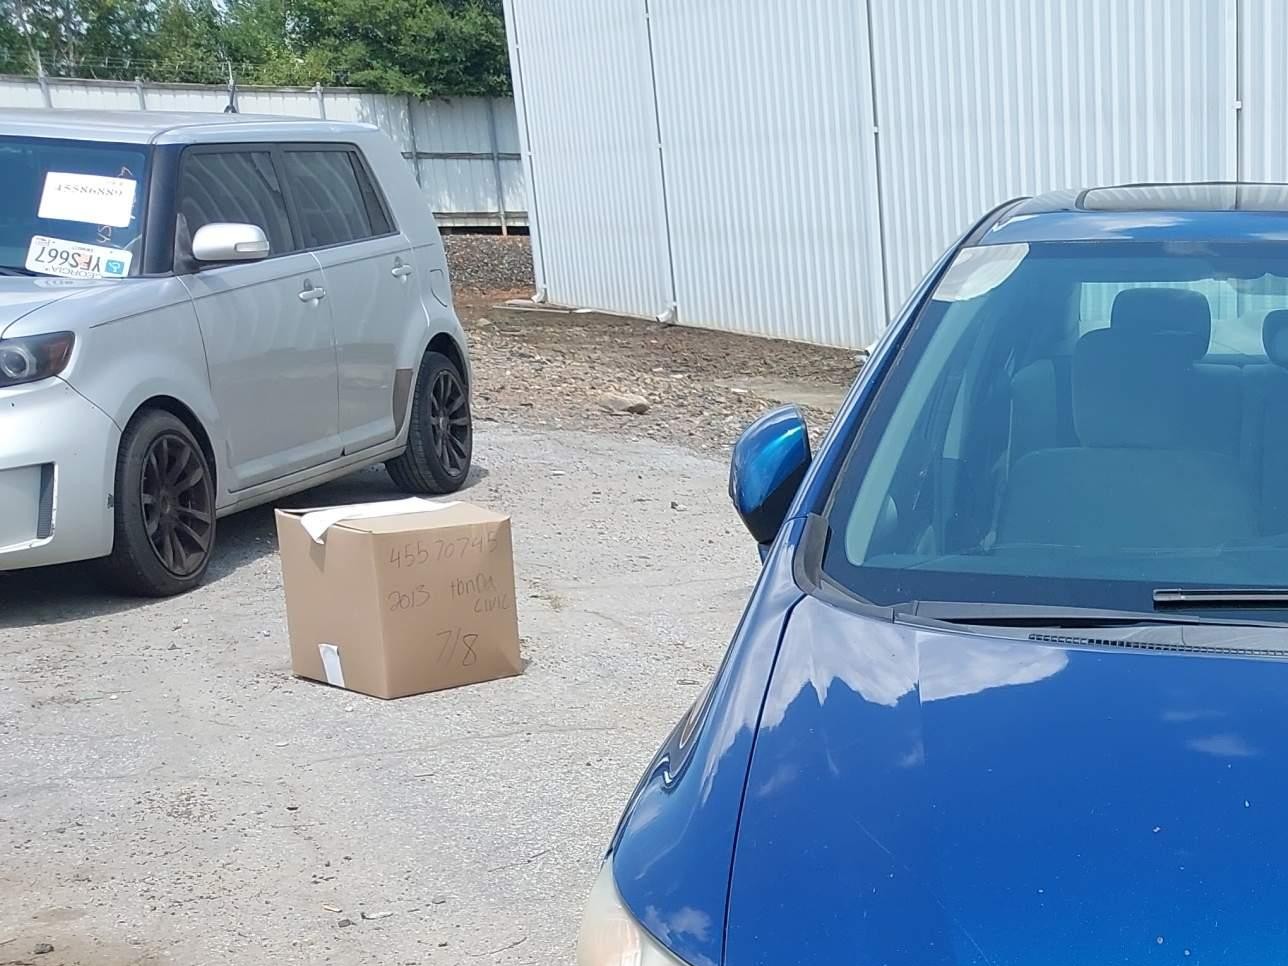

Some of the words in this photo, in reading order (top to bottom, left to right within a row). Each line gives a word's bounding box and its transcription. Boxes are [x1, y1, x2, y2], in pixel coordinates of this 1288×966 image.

[34, 246, 101, 273] YFS667
[390, 531, 498, 568] 45570745
[388, 584, 431, 612] 2013
[435, 627, 479, 668] 7/8
